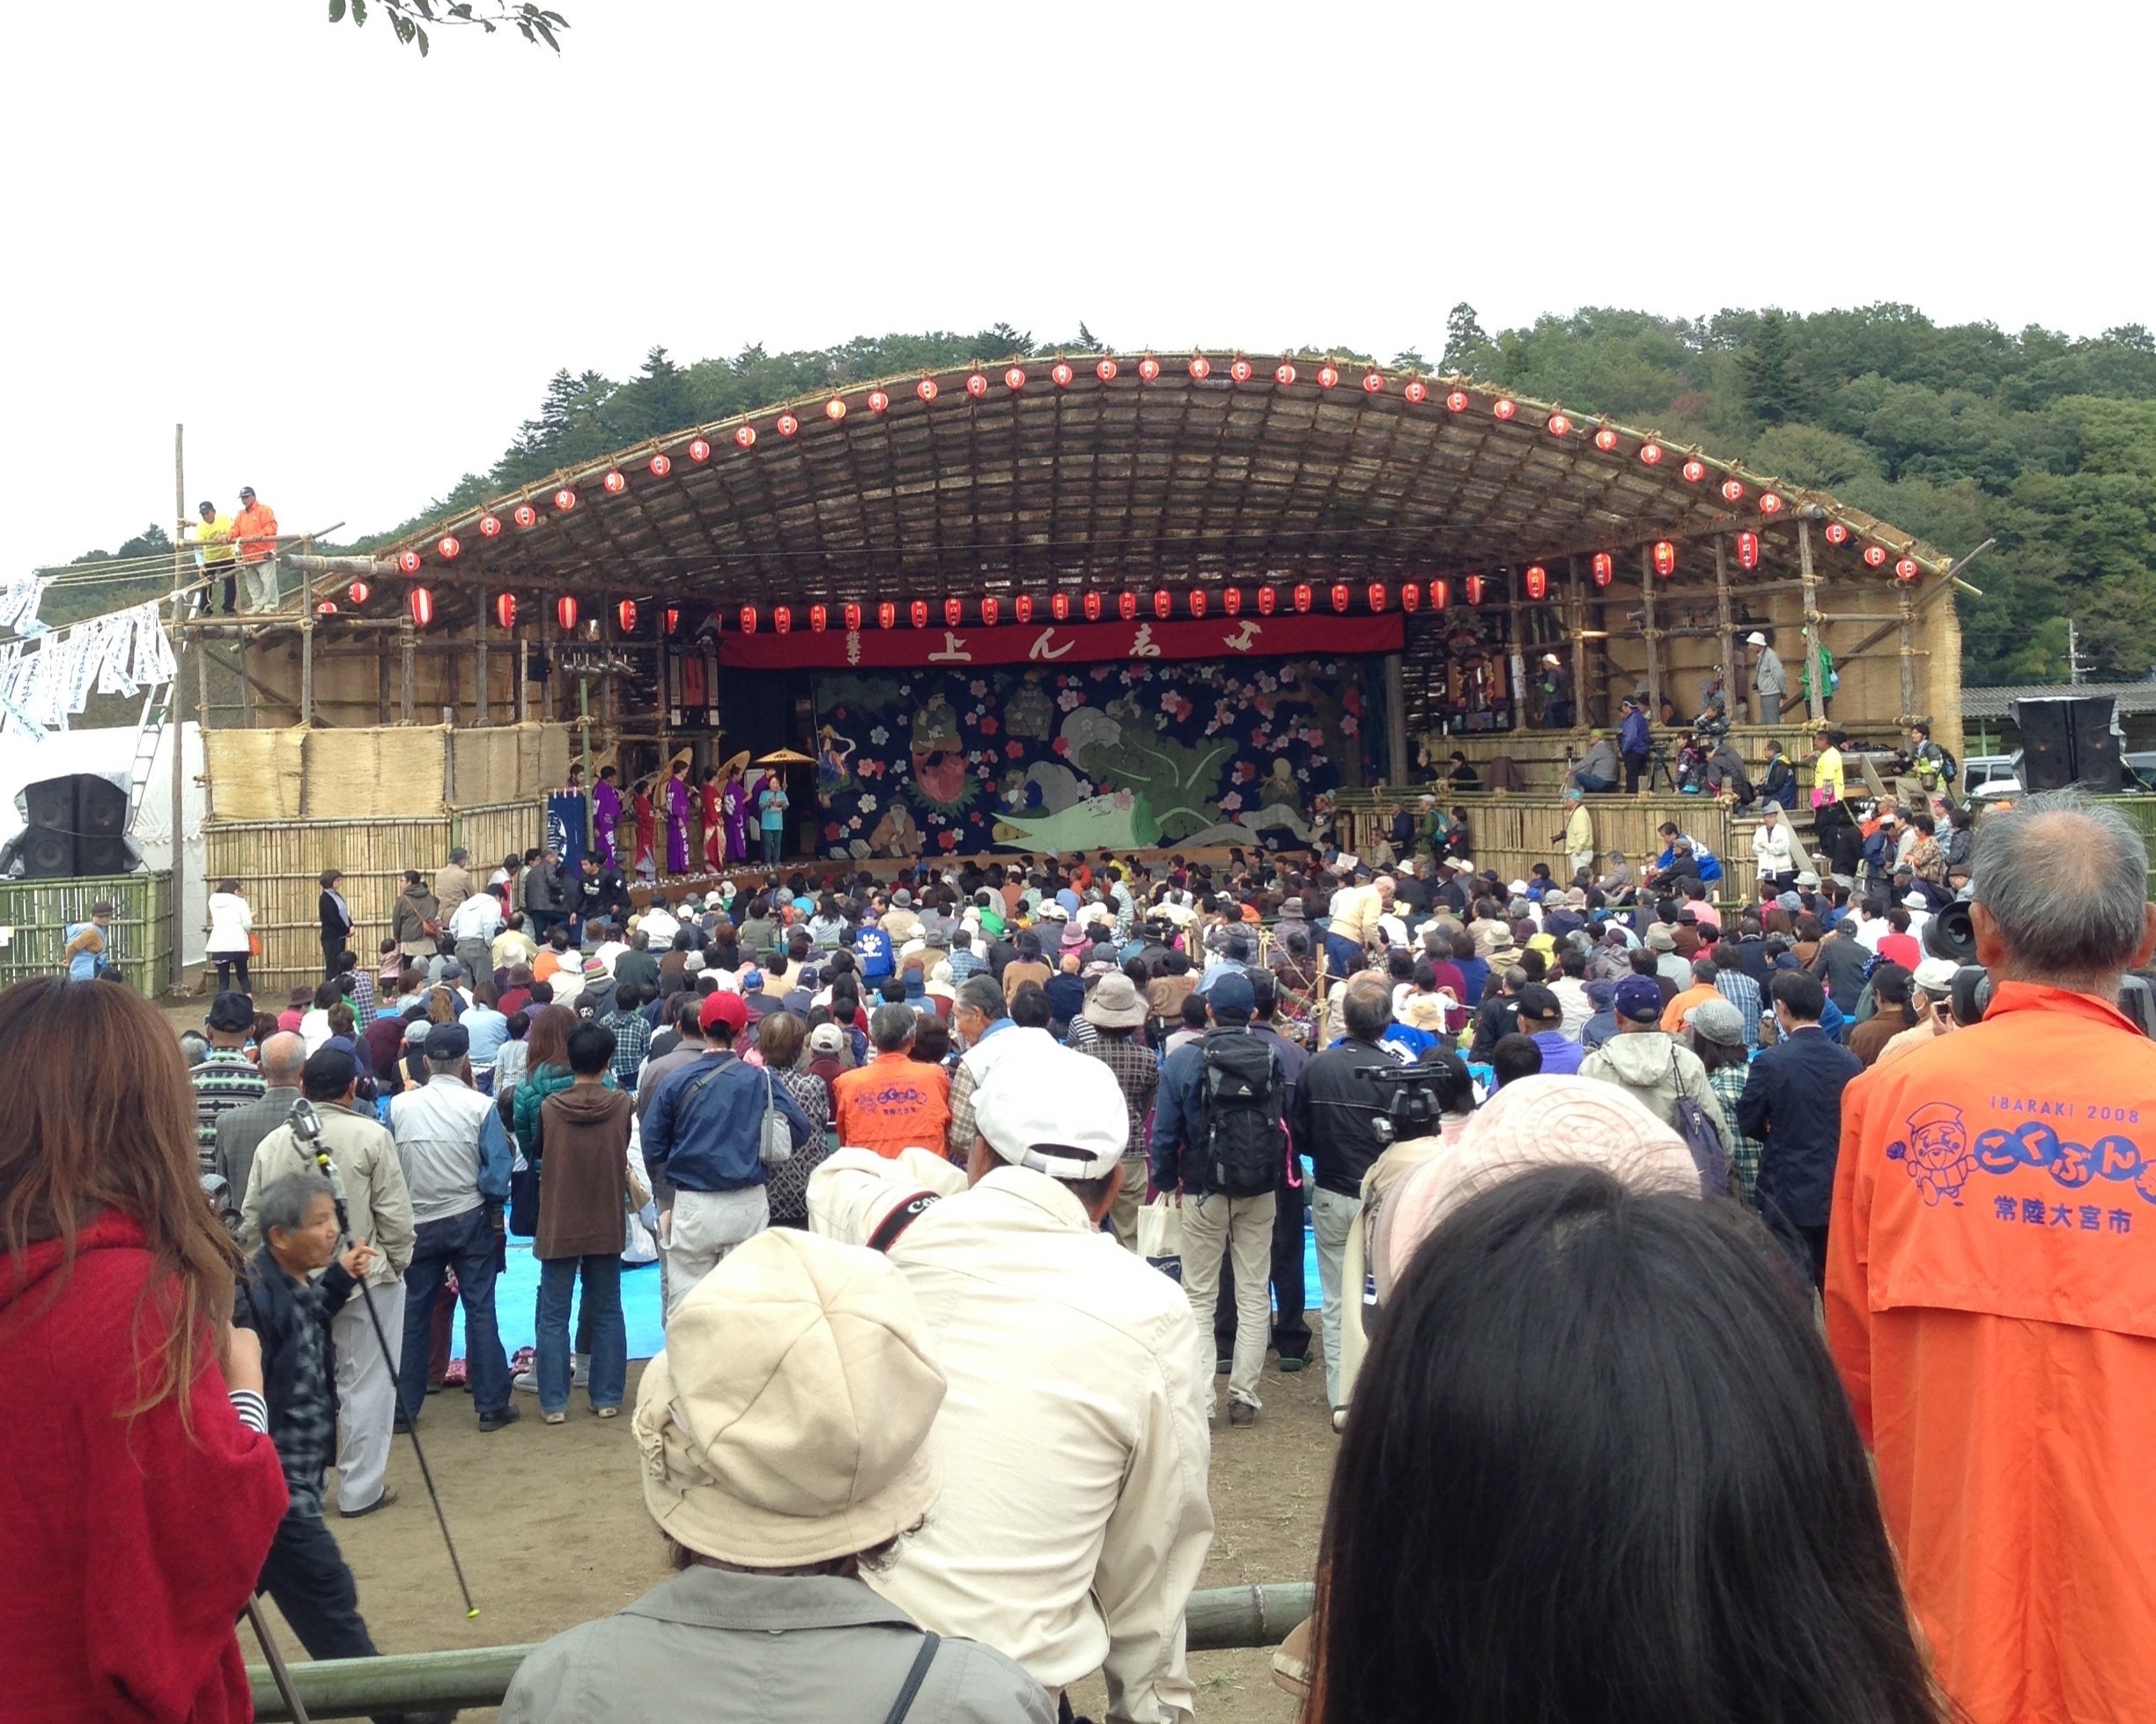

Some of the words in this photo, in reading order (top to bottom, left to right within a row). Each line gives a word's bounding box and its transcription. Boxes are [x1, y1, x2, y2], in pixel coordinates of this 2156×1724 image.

[2086, 1105, 2139, 1124] 2008
[1994, 1193, 2133, 1234] 常陸大宮市
